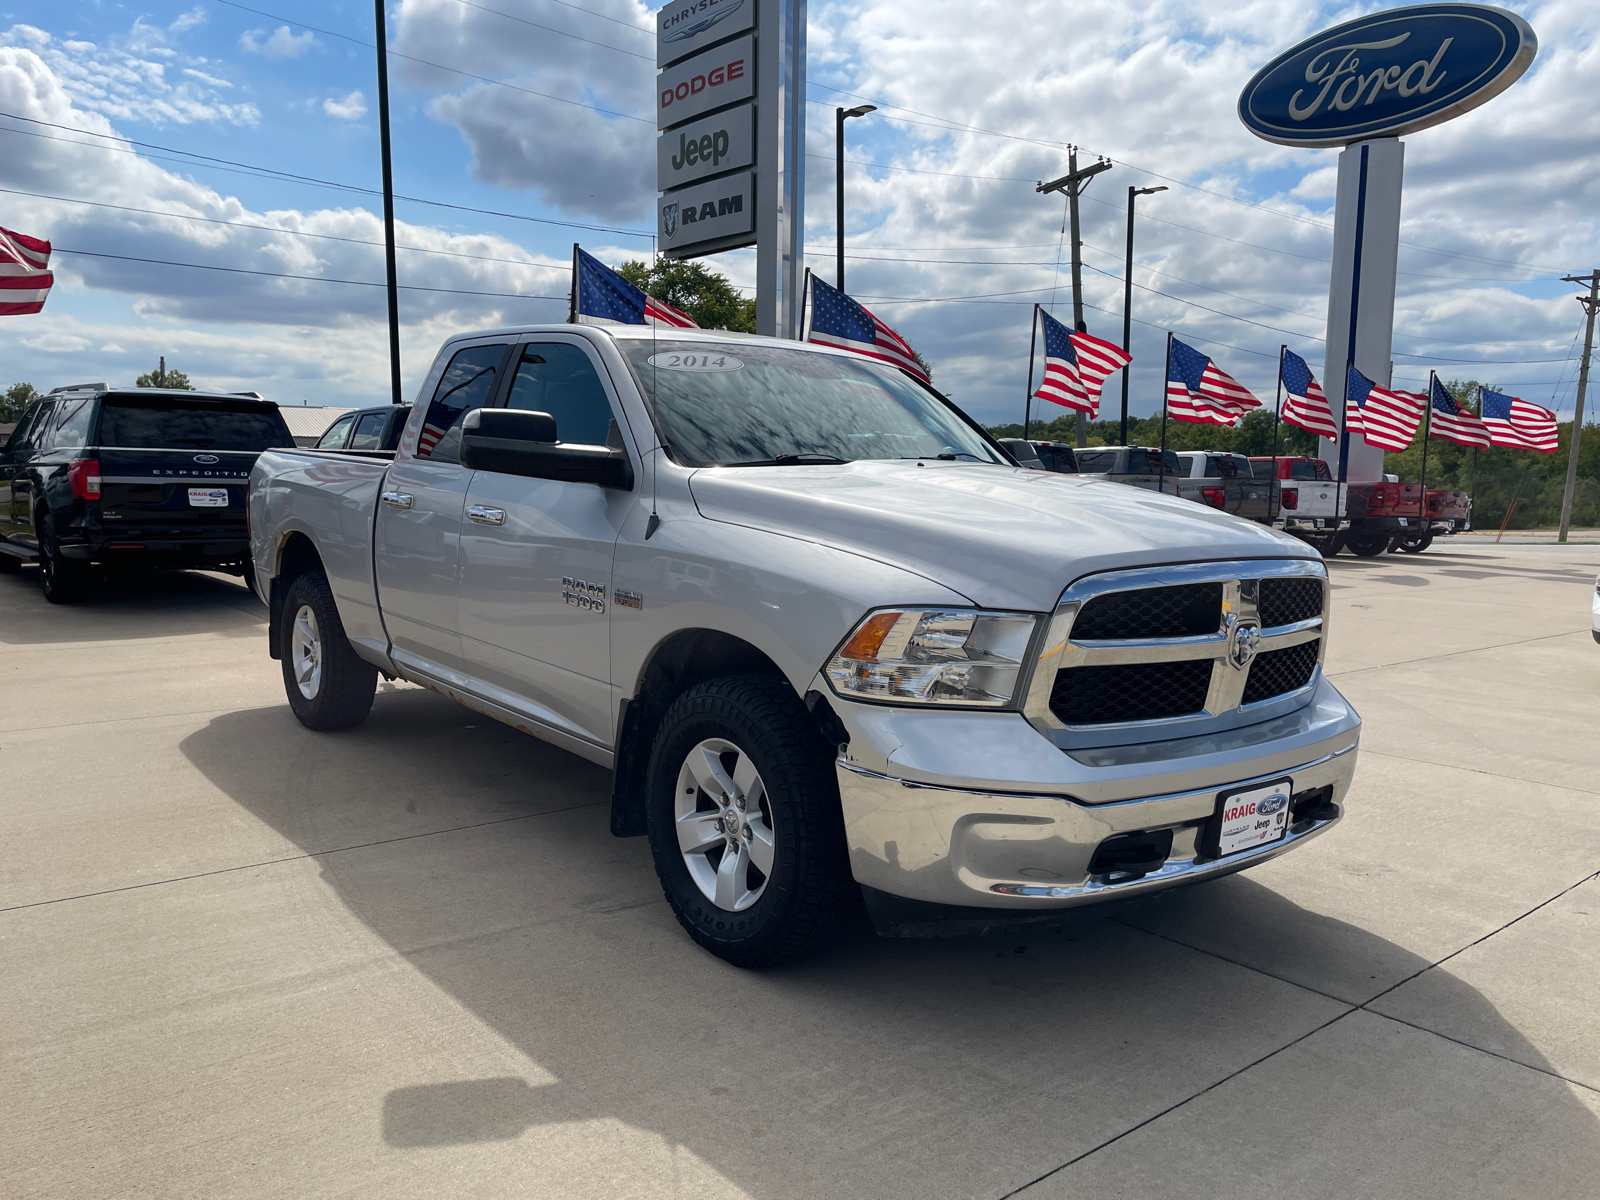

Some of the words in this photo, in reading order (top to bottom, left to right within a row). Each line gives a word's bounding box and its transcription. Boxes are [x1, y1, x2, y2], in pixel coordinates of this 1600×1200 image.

[663, 0, 723, 29] CHRYSL
[661, 59, 744, 108] DODGE
[1288, 31, 1455, 121] Ford
[671, 129, 729, 171] Jeep
[682, 194, 743, 225] RAM
[668, 355, 726, 368] 2014
[153, 469, 249, 477] EXPEDITIO
[562, 575, 605, 599] RAM
[562, 590, 605, 614] 1500
[1224, 803, 1256, 823] KRAIG
[1261, 797, 1282, 813] Ford
[1255, 820, 1271, 830] Jeep
